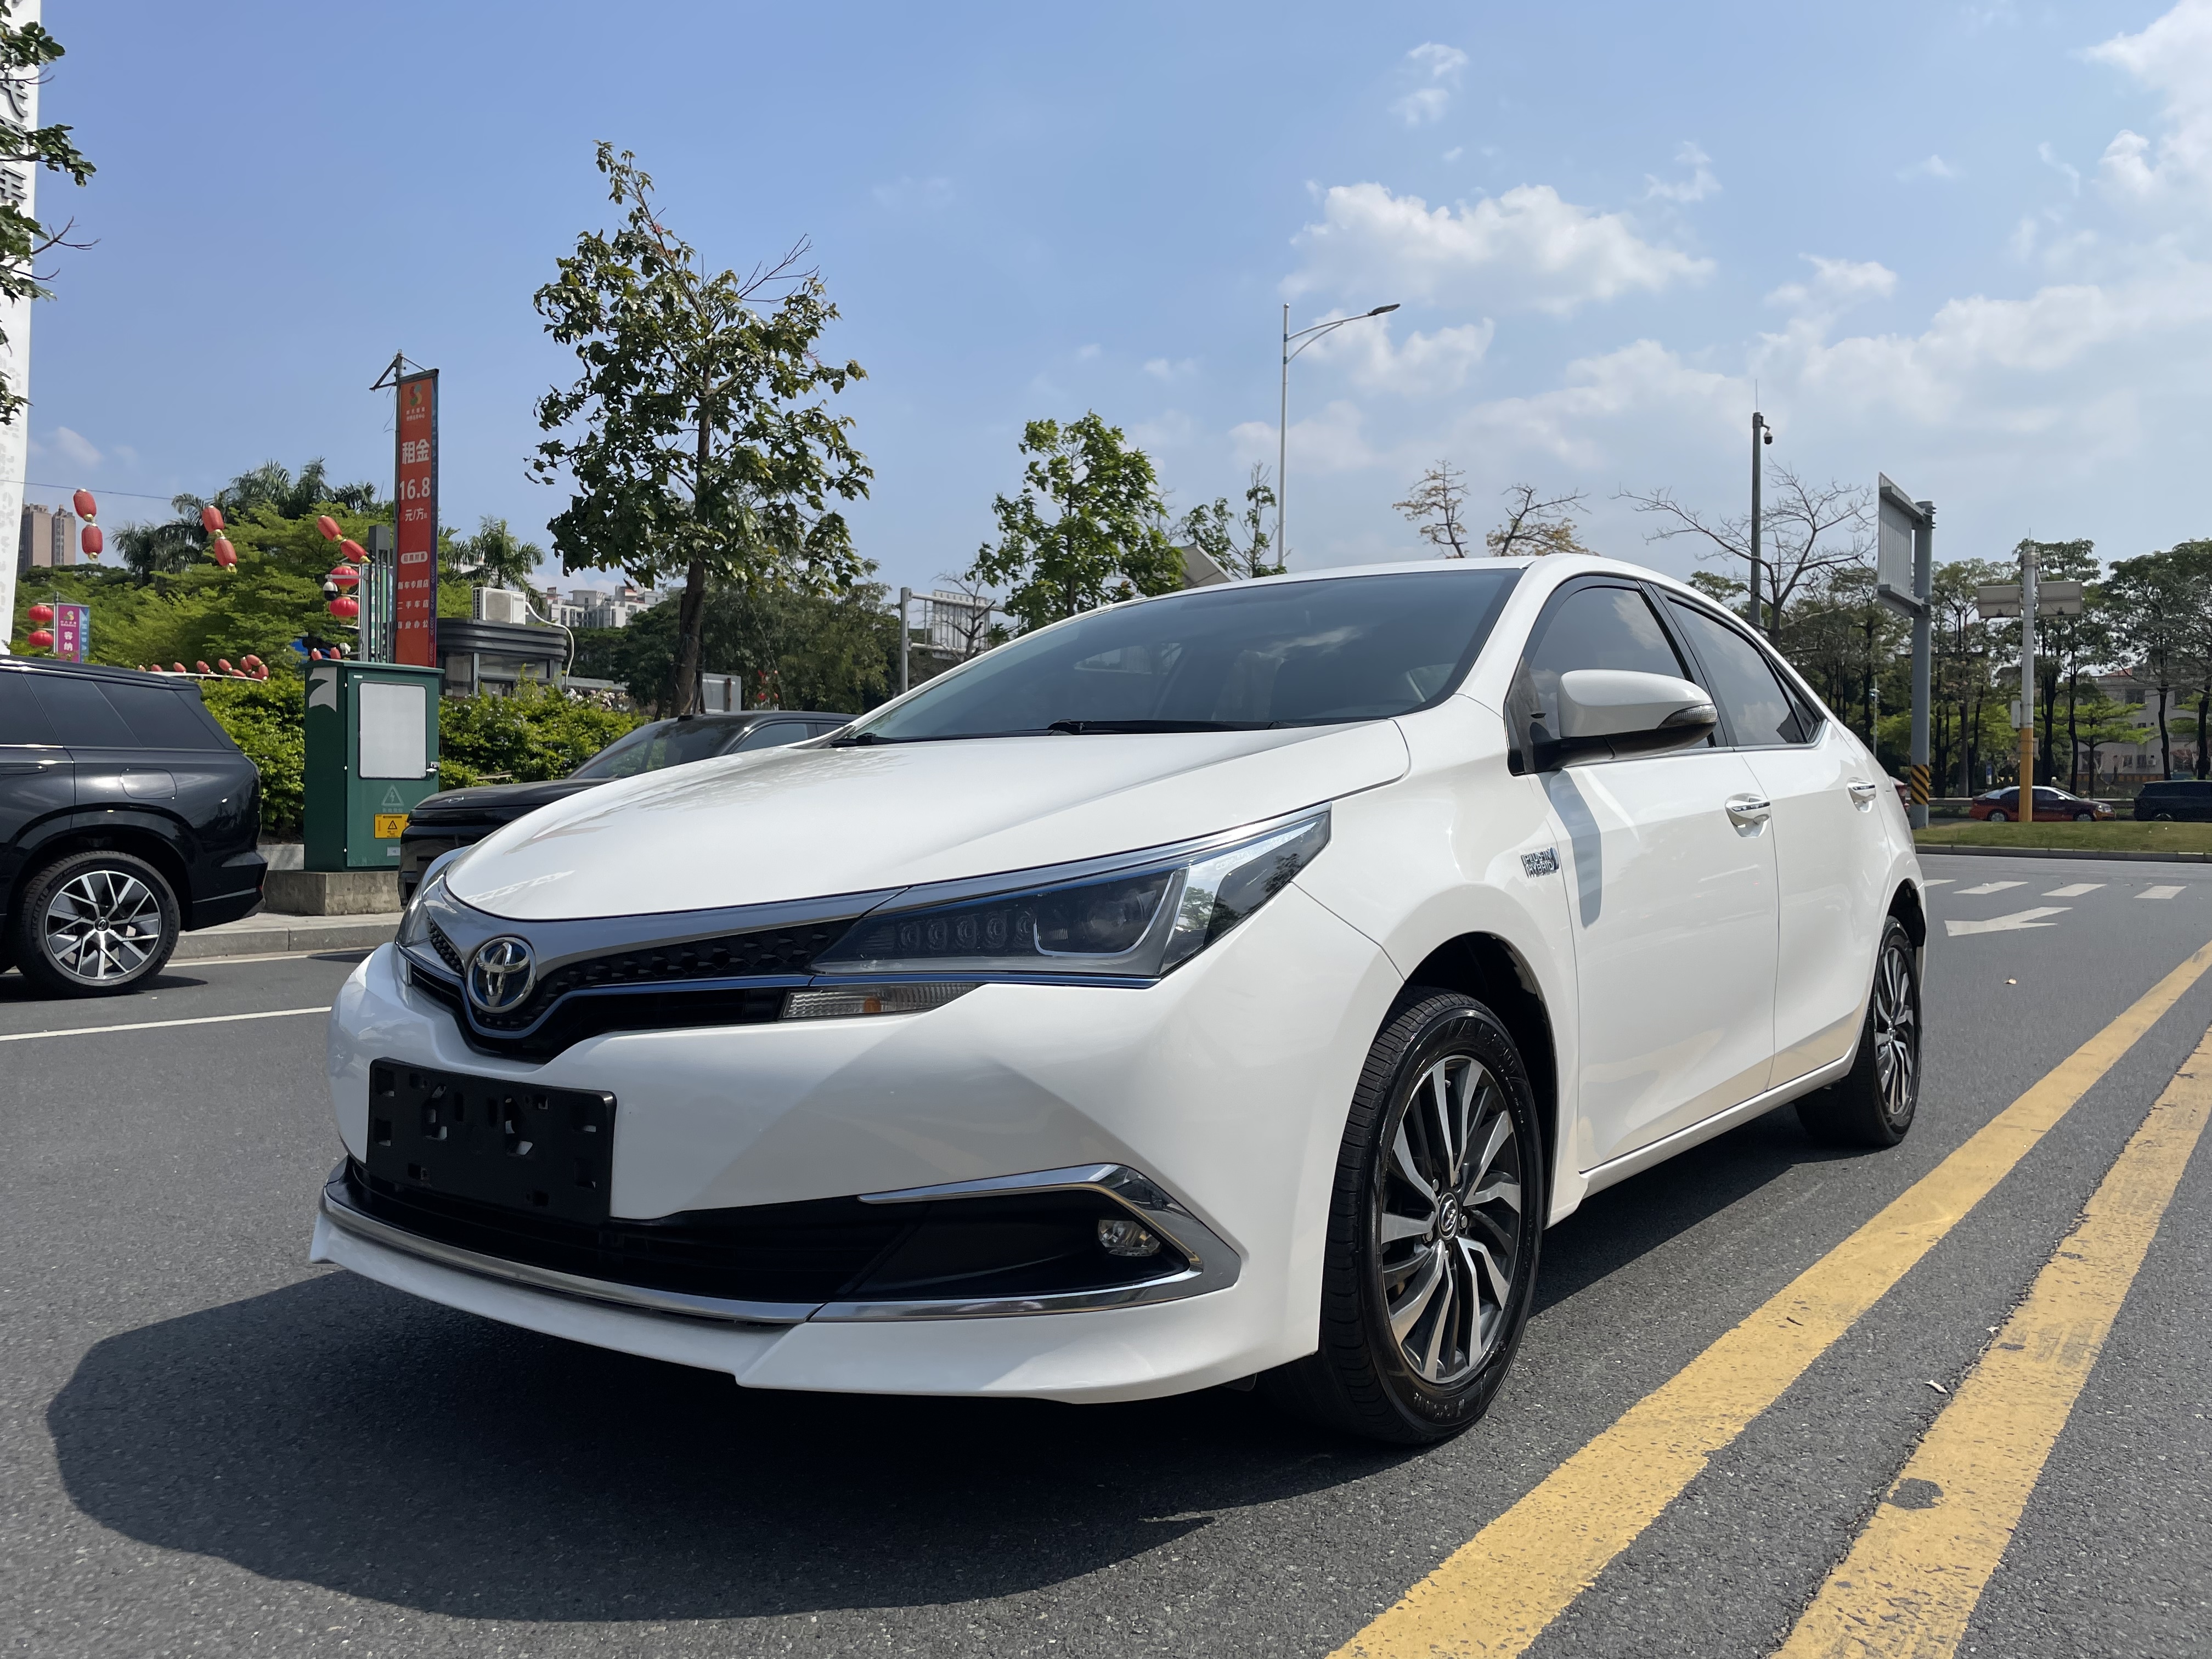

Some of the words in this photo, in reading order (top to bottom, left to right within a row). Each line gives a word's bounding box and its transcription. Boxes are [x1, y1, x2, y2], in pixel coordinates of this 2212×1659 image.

[402, 439, 430, 465] 租金
[399, 477, 430, 500] 16.8
[1527, 860, 1554, 876] HYBRID
